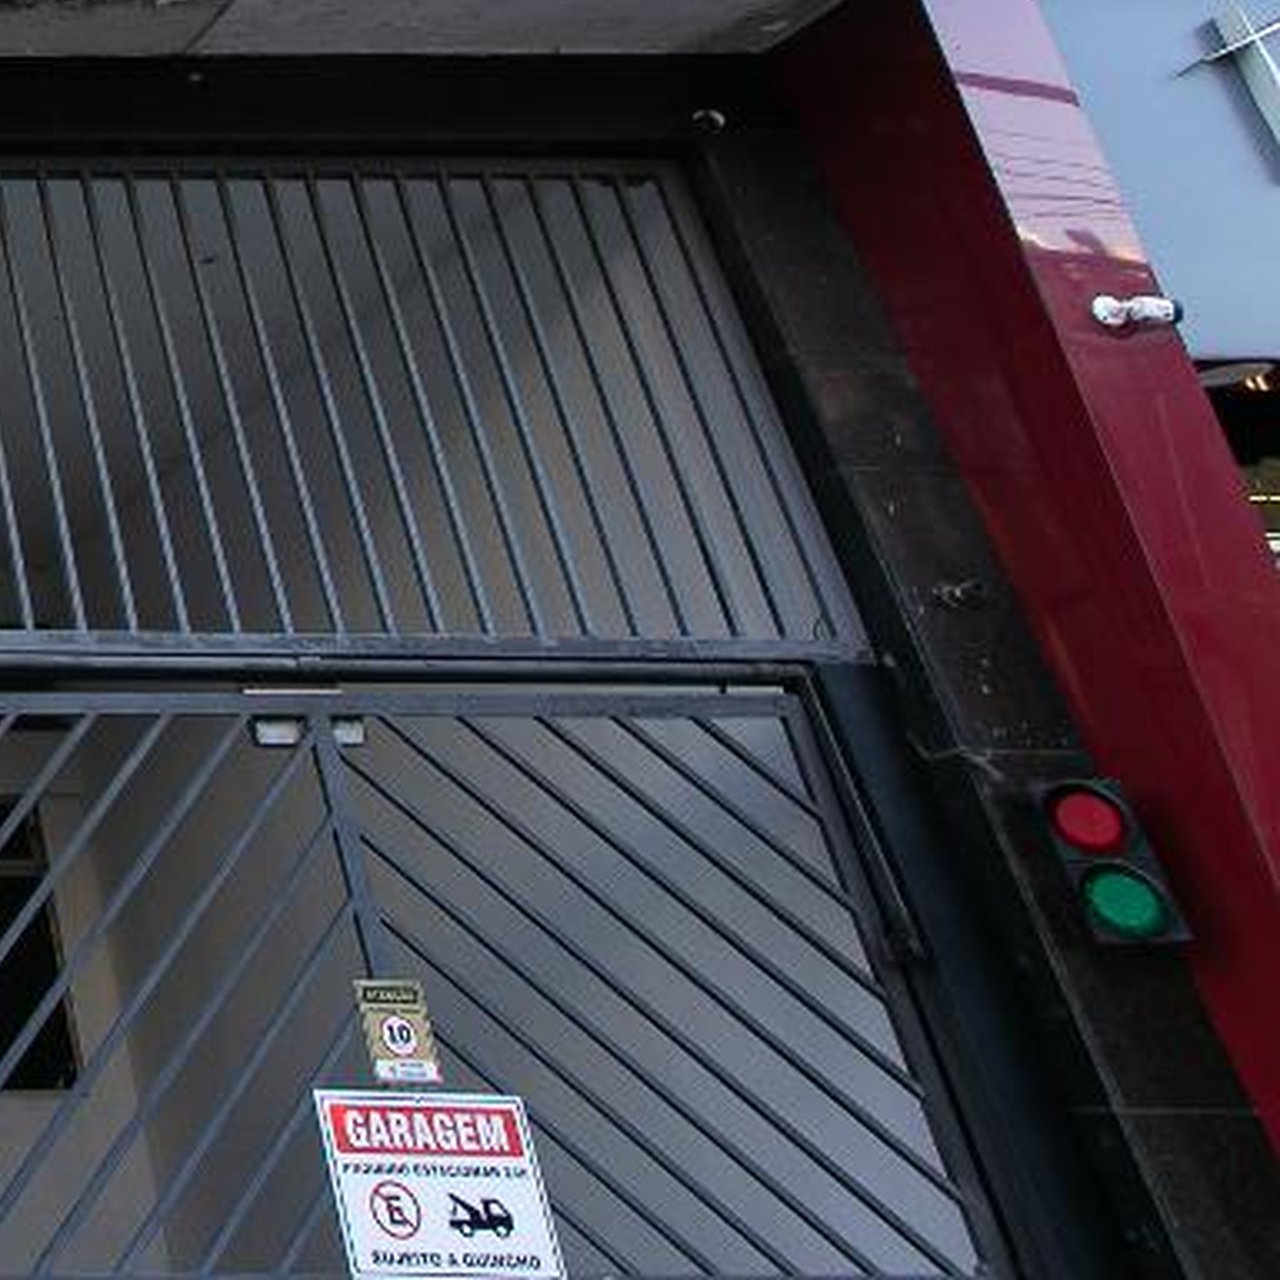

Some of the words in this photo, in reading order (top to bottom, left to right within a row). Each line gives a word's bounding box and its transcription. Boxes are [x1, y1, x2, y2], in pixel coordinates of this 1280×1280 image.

[386, 1024, 411, 1044] 10
[344, 1109, 510, 1152] GARAGEM
[371, 1250, 441, 1267] SUJEITO
[463, 1252, 541, 1270] GUINCHO
